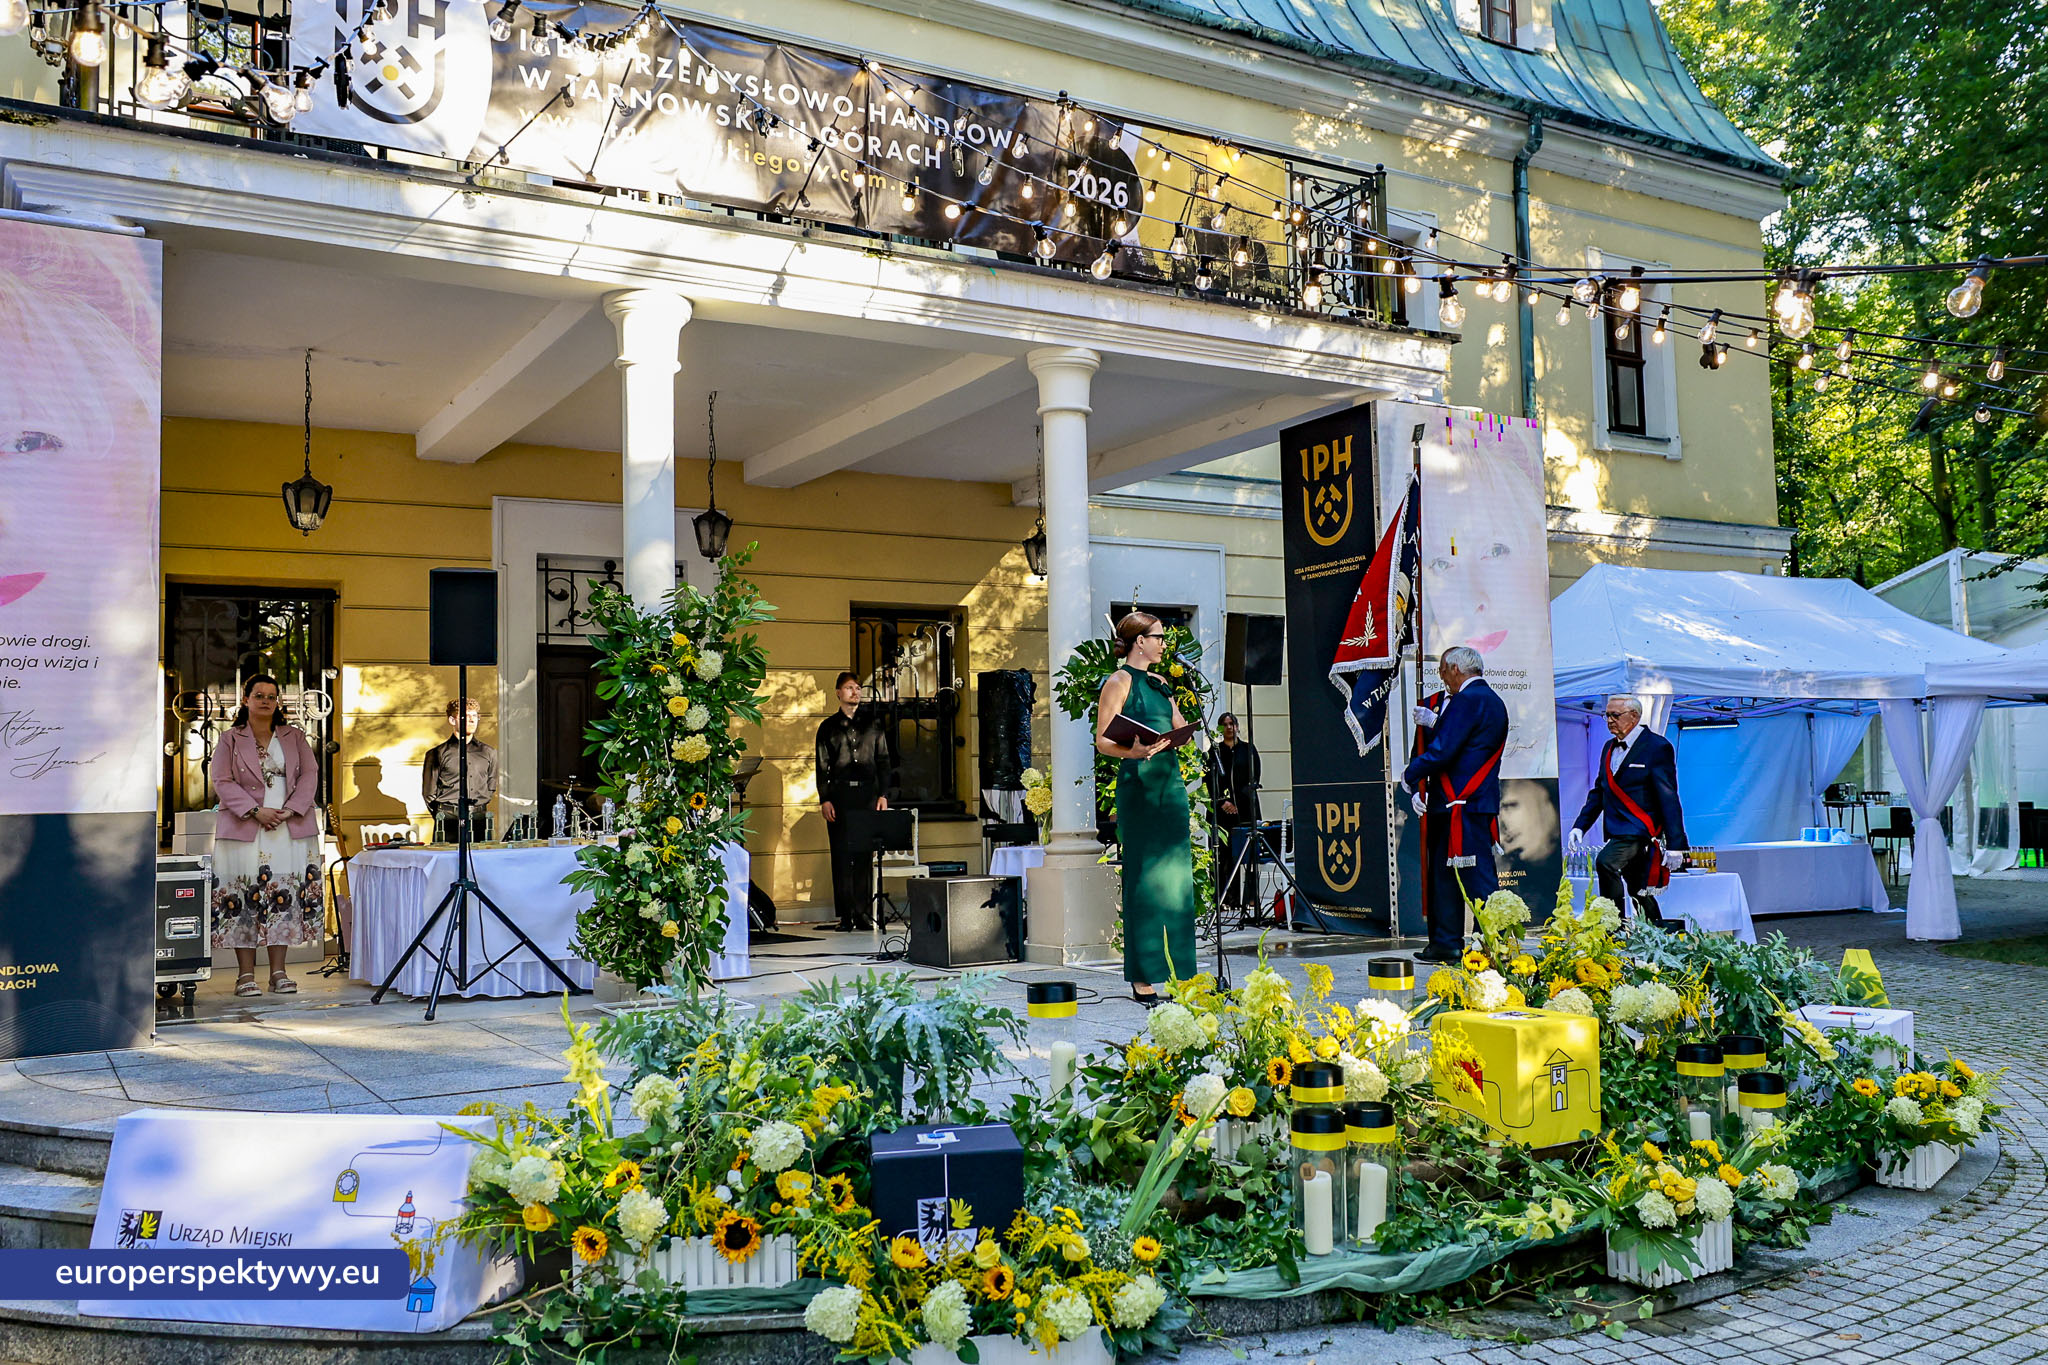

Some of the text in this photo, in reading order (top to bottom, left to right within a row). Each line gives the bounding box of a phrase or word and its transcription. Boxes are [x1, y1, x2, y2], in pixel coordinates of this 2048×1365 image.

[617, 41, 1030, 155] RZEMYSŁOWO-HANDLOWA
[518, 64, 942, 170] W TARNOWSKH GÓRACH
[1067, 169, 1129, 208] 2026
[1300, 434, 1353, 482] IPH
[41, 634, 91, 651] drogi.
[44, 655, 89, 671] wizja
[93, 656, 99, 668] i
[0, 675, 21, 689] ie.
[1314, 802, 1361, 834] IPH
